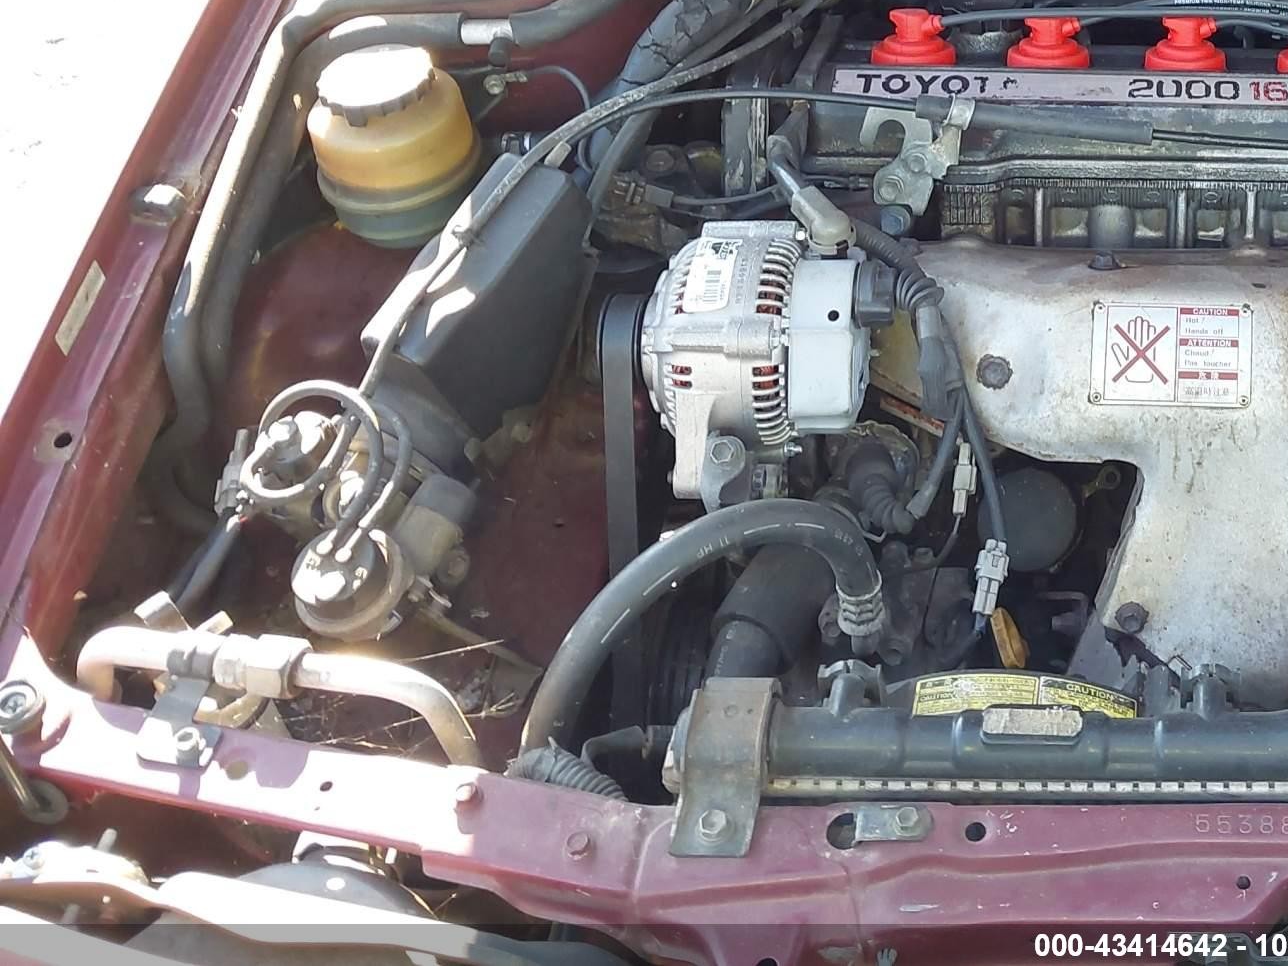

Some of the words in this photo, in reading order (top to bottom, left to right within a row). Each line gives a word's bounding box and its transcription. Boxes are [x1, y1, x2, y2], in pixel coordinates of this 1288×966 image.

[1127, 78, 1241, 101] 2000
[1192, 308, 1228, 316] CAUTION
[1212, 327, 1224, 336] off
[1186, 339, 1232, 347] ATTENTION
[1065, 682, 1114, 701] CAUTION
